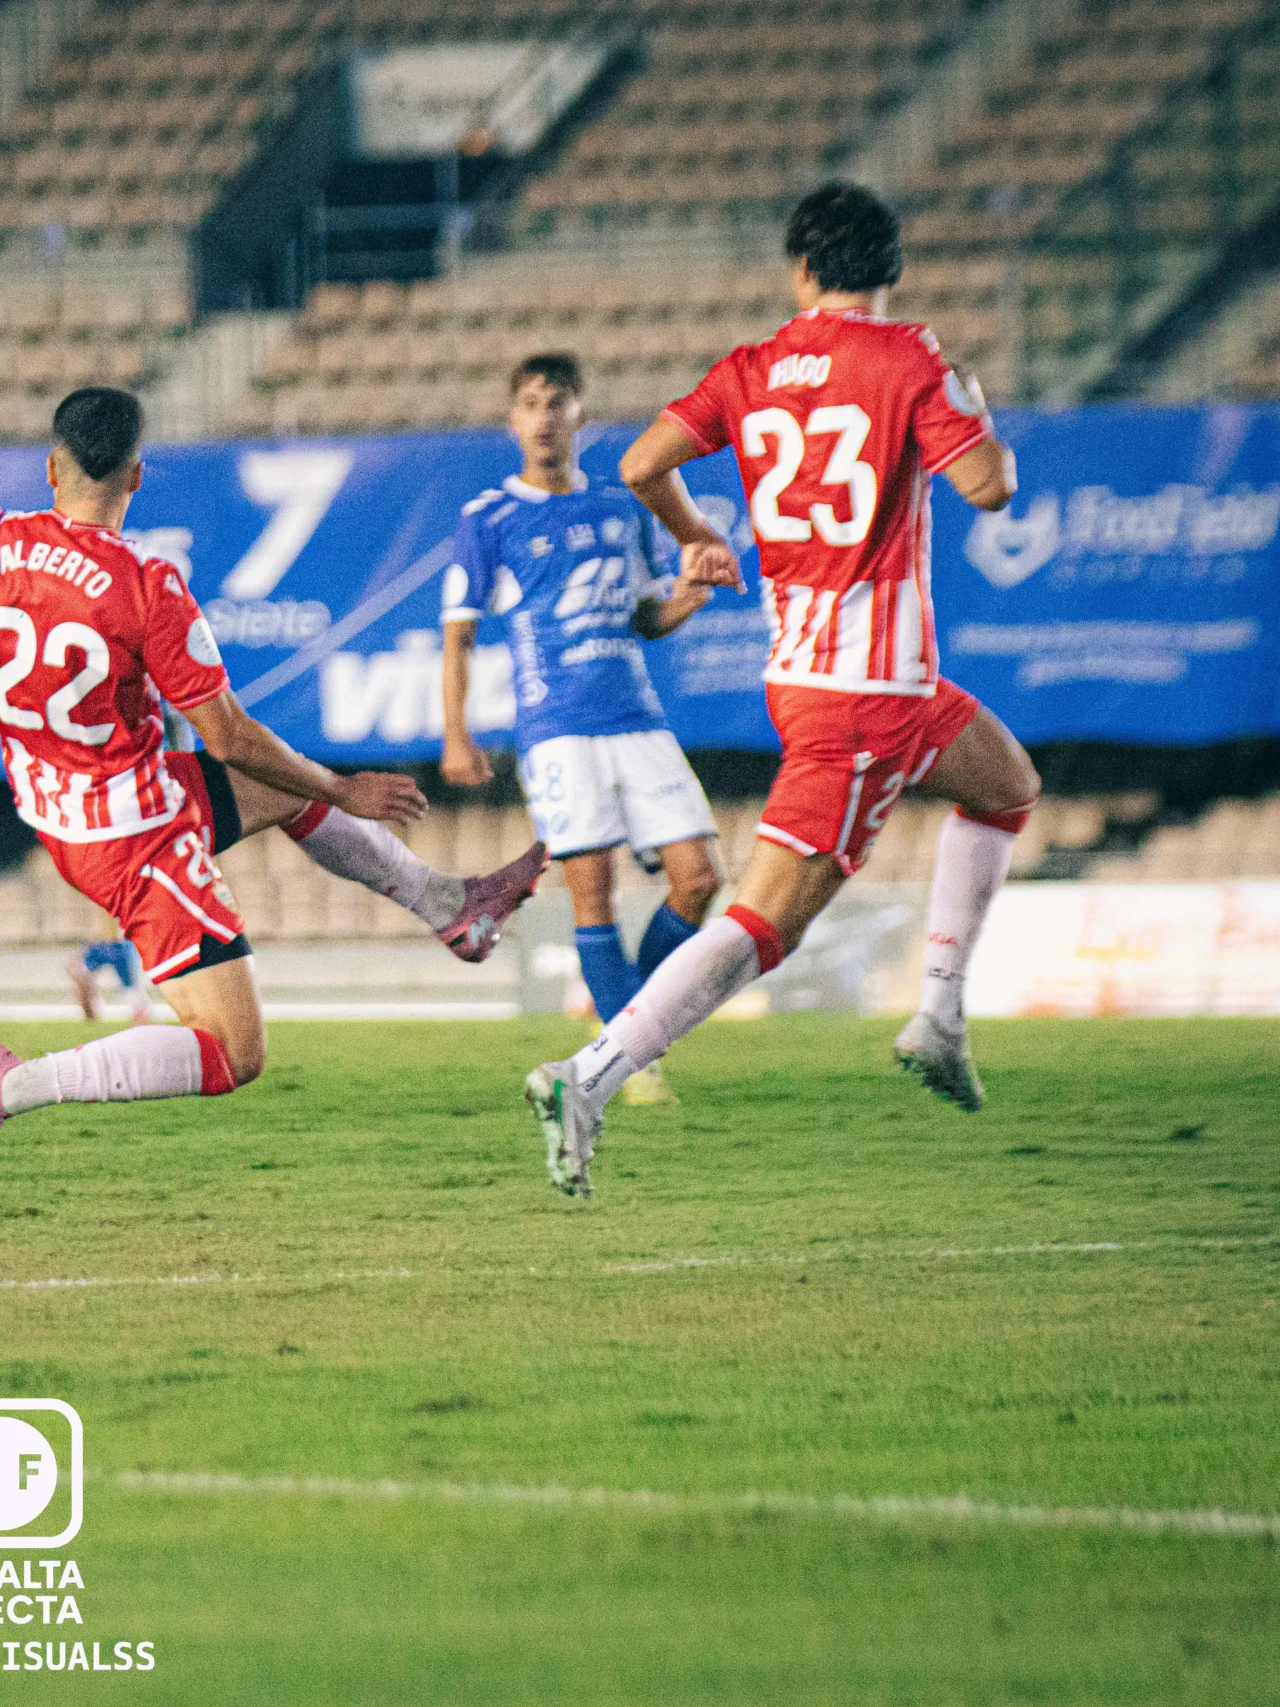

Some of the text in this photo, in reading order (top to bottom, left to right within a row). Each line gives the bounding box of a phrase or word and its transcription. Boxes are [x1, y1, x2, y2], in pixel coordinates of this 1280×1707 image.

[767, 353, 832, 391] HUGO
[237, 446, 355, 602] 7
[741, 404, 877, 545] 23
[0, 539, 113, 599] ALBERTO
